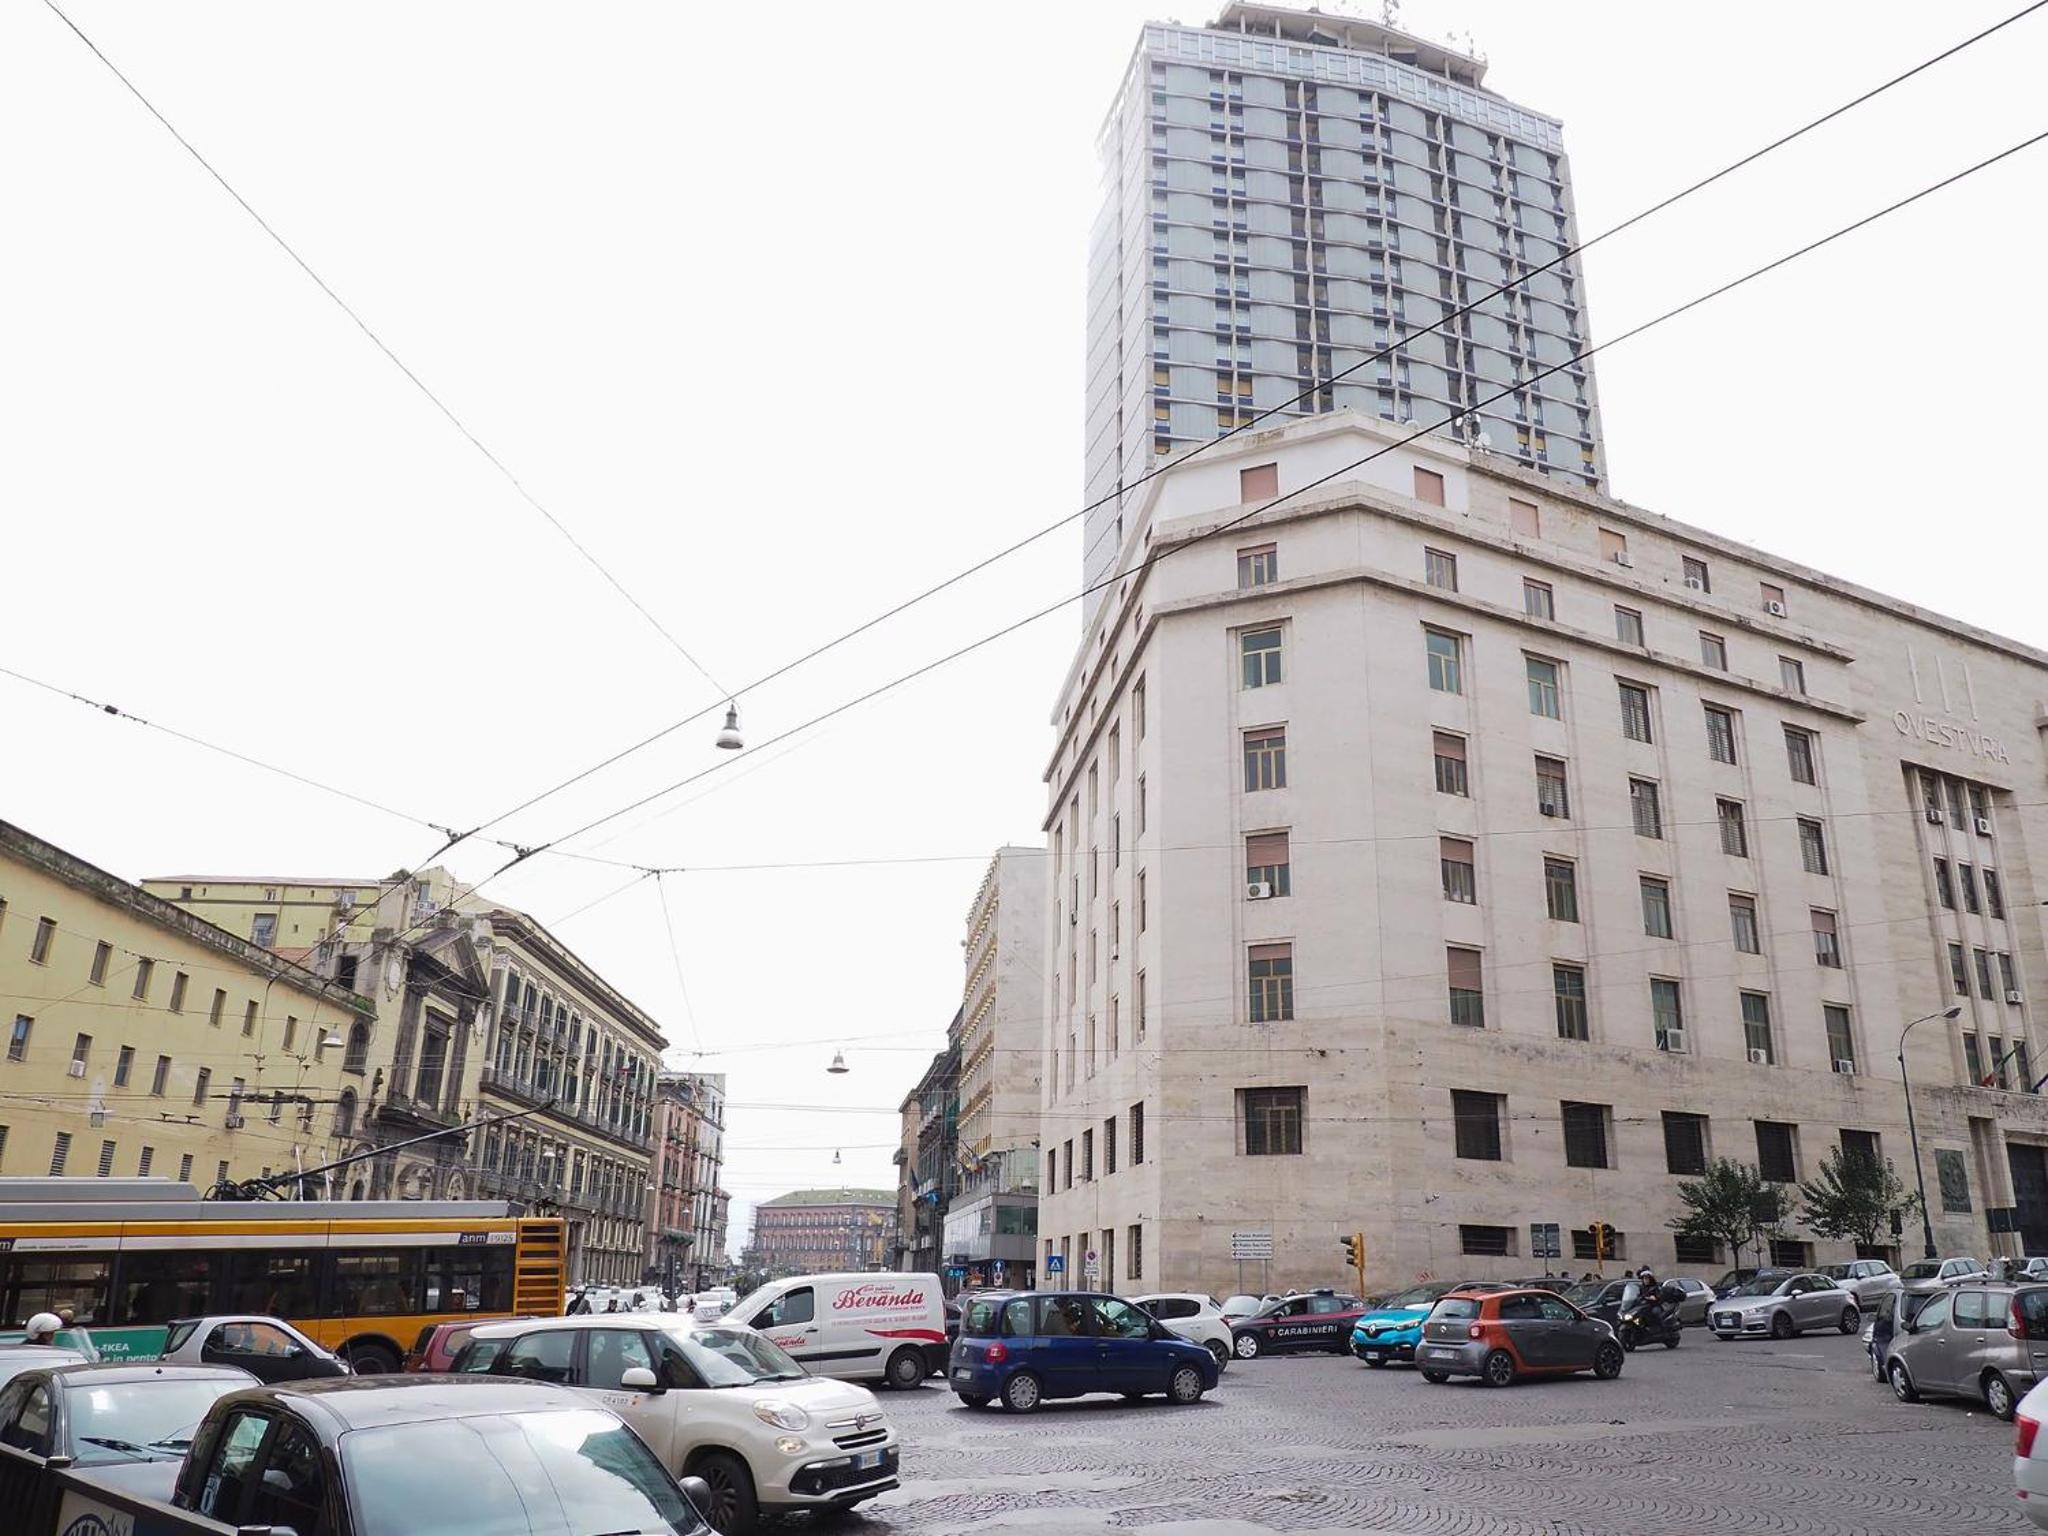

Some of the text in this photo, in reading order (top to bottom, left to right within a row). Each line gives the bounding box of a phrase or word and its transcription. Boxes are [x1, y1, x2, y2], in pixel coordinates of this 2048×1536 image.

[1893, 710, 2010, 766] QVESTVRA
[462, 1234, 487, 1243] anm
[832, 1288, 924, 1310] Bevanda
[1277, 1324, 1338, 1337] CARABINIERI
